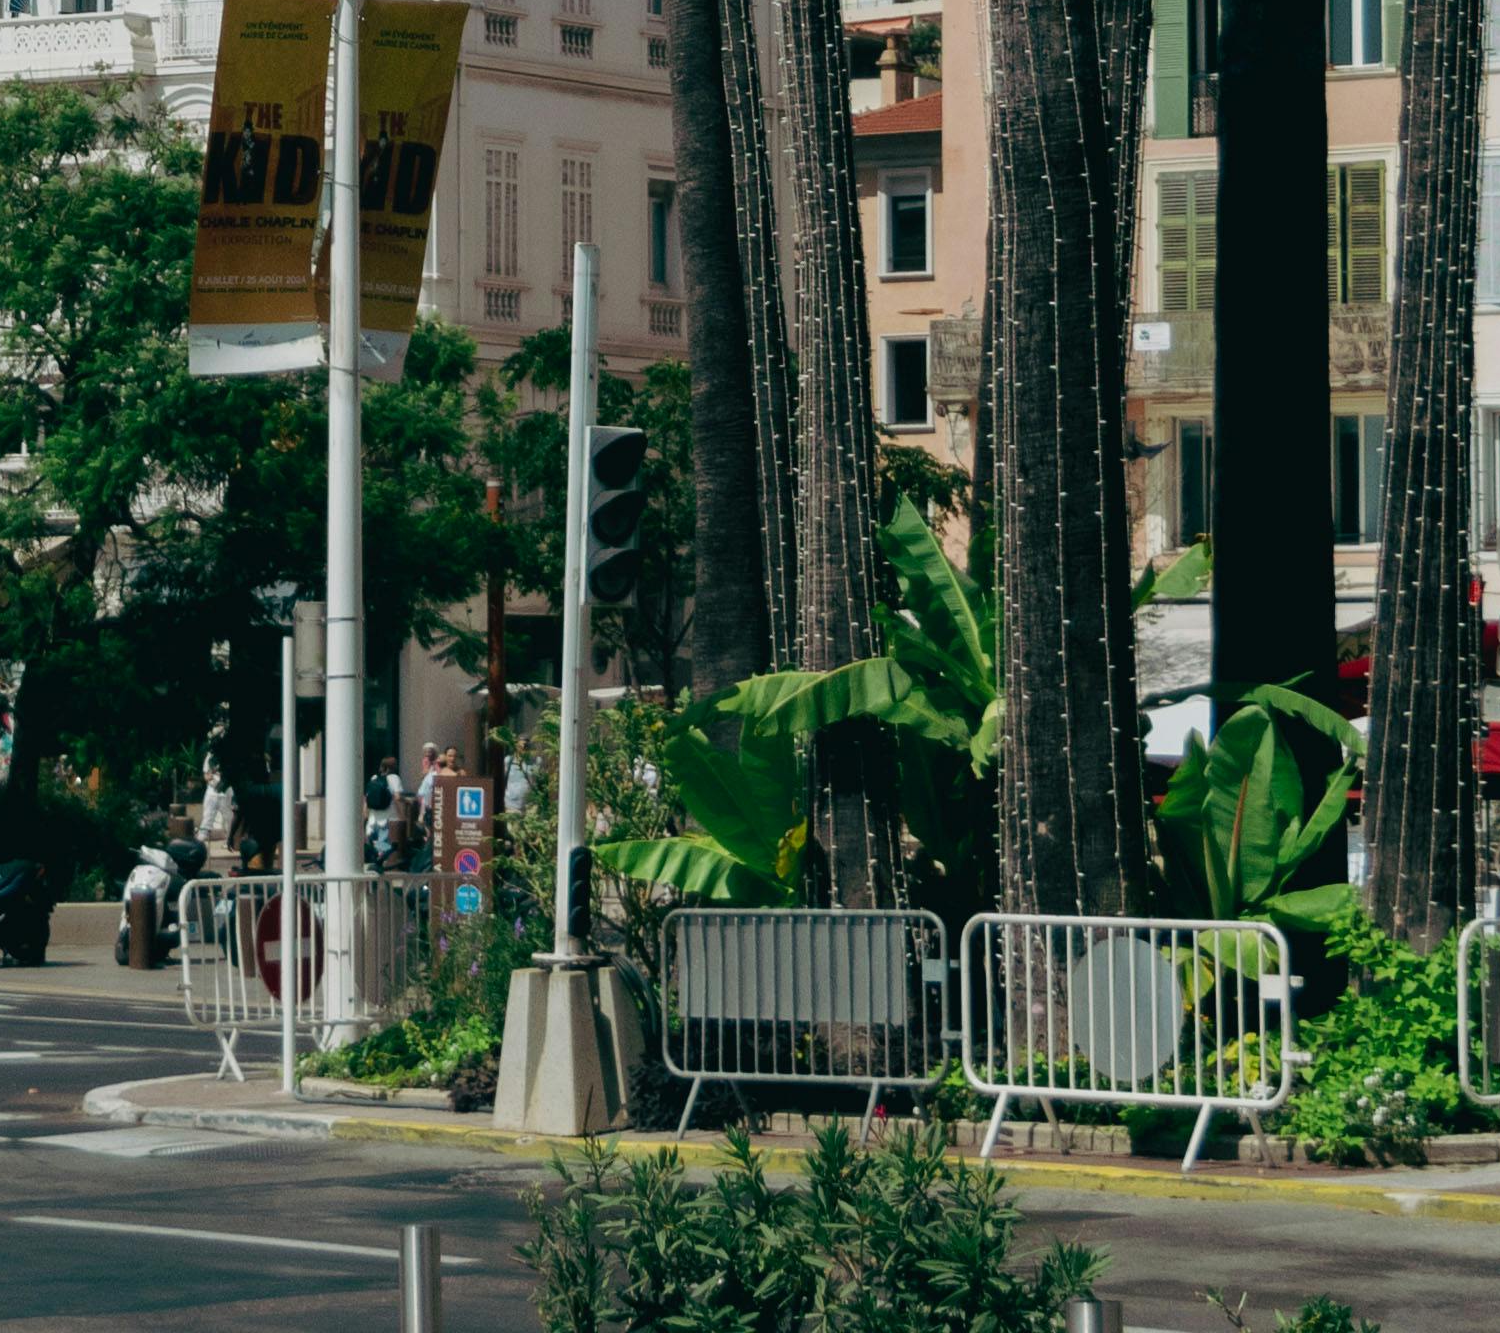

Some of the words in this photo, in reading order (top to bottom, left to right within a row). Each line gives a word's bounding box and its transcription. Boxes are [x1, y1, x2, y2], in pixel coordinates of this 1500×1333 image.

[242, 100, 284, 130] THE
[203, 130, 321, 206] KID
[200, 216, 251, 229] CHARLIE
[255, 215, 316, 229] CHAPLIN
[434, 786, 443, 829] GAULLE
